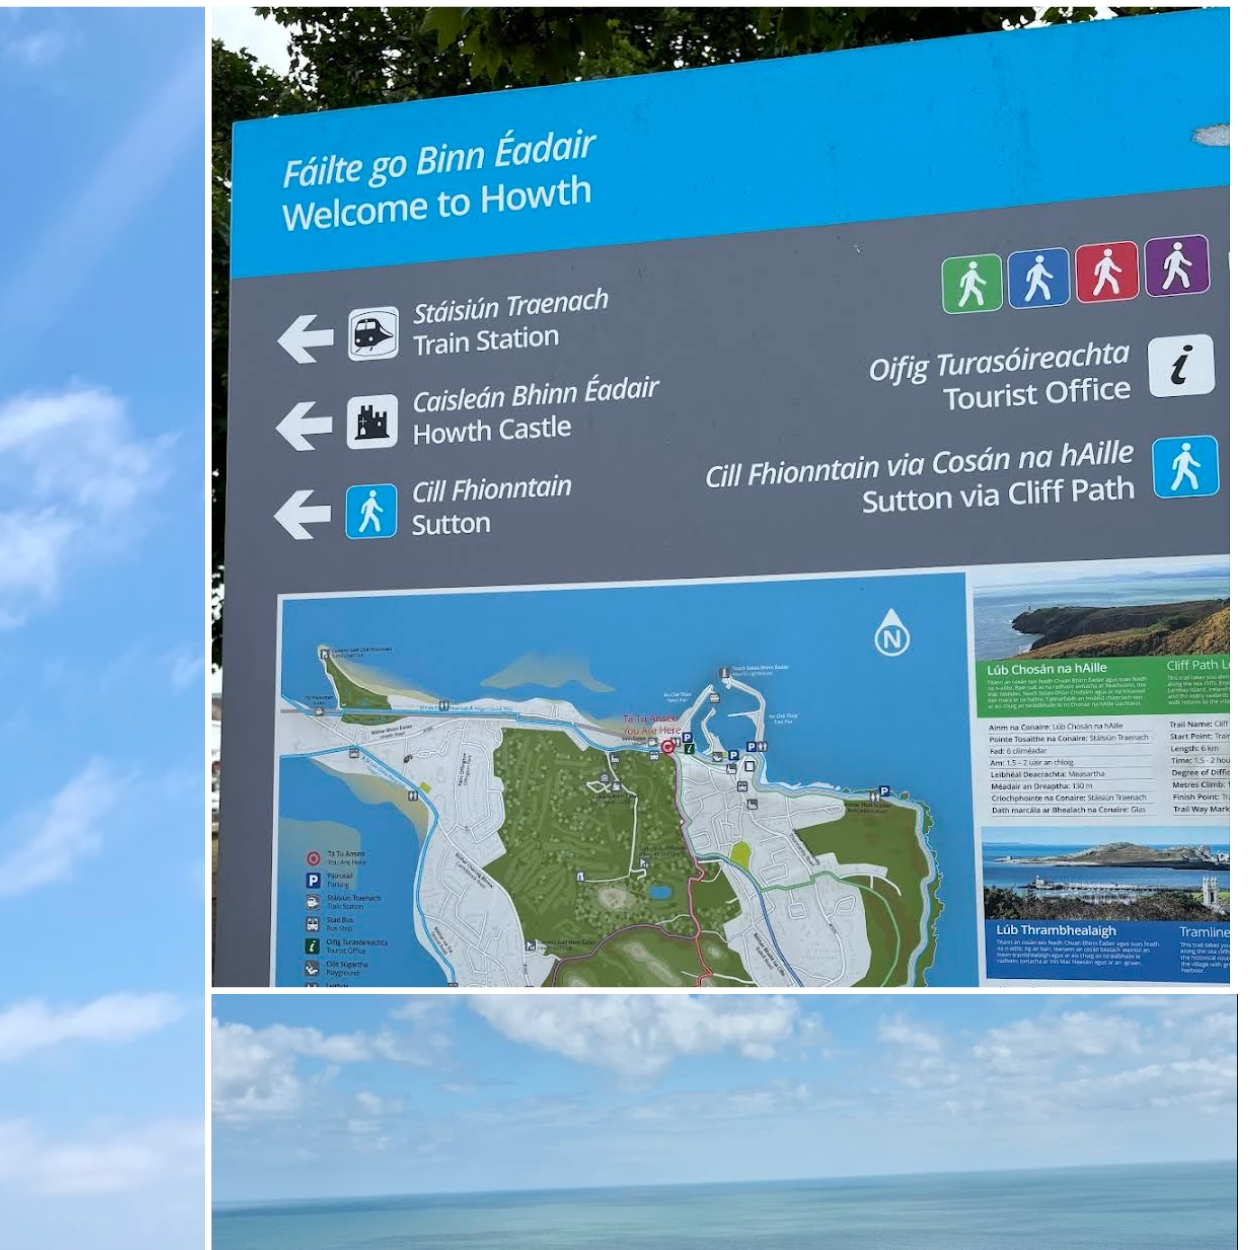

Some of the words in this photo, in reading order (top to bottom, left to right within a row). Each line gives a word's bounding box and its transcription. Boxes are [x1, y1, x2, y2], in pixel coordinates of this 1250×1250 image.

[284, 155, 362, 187] Fáilte
[369, 156, 406, 188] go
[417, 144, 484, 174] Binn
[496, 129, 596, 166] Éadair
[283, 198, 427, 231] Welcome
[438, 192, 470, 217] to
[482, 175, 590, 213] Howth
[414, 298, 498, 324] Stáisiún
[508, 288, 608, 316] Traenach
[413, 333, 469, 355] Train
[477, 327, 558, 350] Station
[870, 356, 930, 386] Oifig
[938, 342, 1129, 376] Turasóireachta
[414, 386, 504, 412] Caisleán
[512, 383, 577, 406] Bhinn
[585, 374, 660, 401] Éadair
[943, 384, 1037, 410] Tourist
[1046, 378, 1130, 403] Office
[414, 420, 491, 444] Howth
[500, 415, 571, 439] Castle
[707, 464, 742, 487] Cill
[749, 456, 879, 485] Fhionntain
[888, 453, 924, 476] via
[933, 447, 1010, 473] Cosán
[1019, 452, 1052, 468] na
[1061, 440, 1134, 466] hAille
[413, 480, 446, 502] Cill
[452, 475, 571, 500] Fhionntain
[863, 490, 952, 513] Sutton
[960, 484, 999, 507] via
[1009, 479, 1064, 504] Cliff
[1072, 476, 1134, 501] Path
[413, 515, 490, 535] Sutton
[884, 630, 901, 648] N
[987, 665, 1009, 676] Lúb
[1012, 664, 1054, 675] Chosán
[1057, 665, 1072, 674] na
[1075, 663, 1107, 673] hAille
[1167, 659, 1190, 671] Cliff
[1192, 659, 1219, 670] Path
[1222, 658, 1230, 670] L
[1214, 720, 1229, 728] Cliff
[1171, 769, 1199, 777] Degree
[1191, 806, 1209, 814] Way
[996, 924, 1018, 935] Lúb
[1021, 924, 1117, 939] Thrambhealaigh
